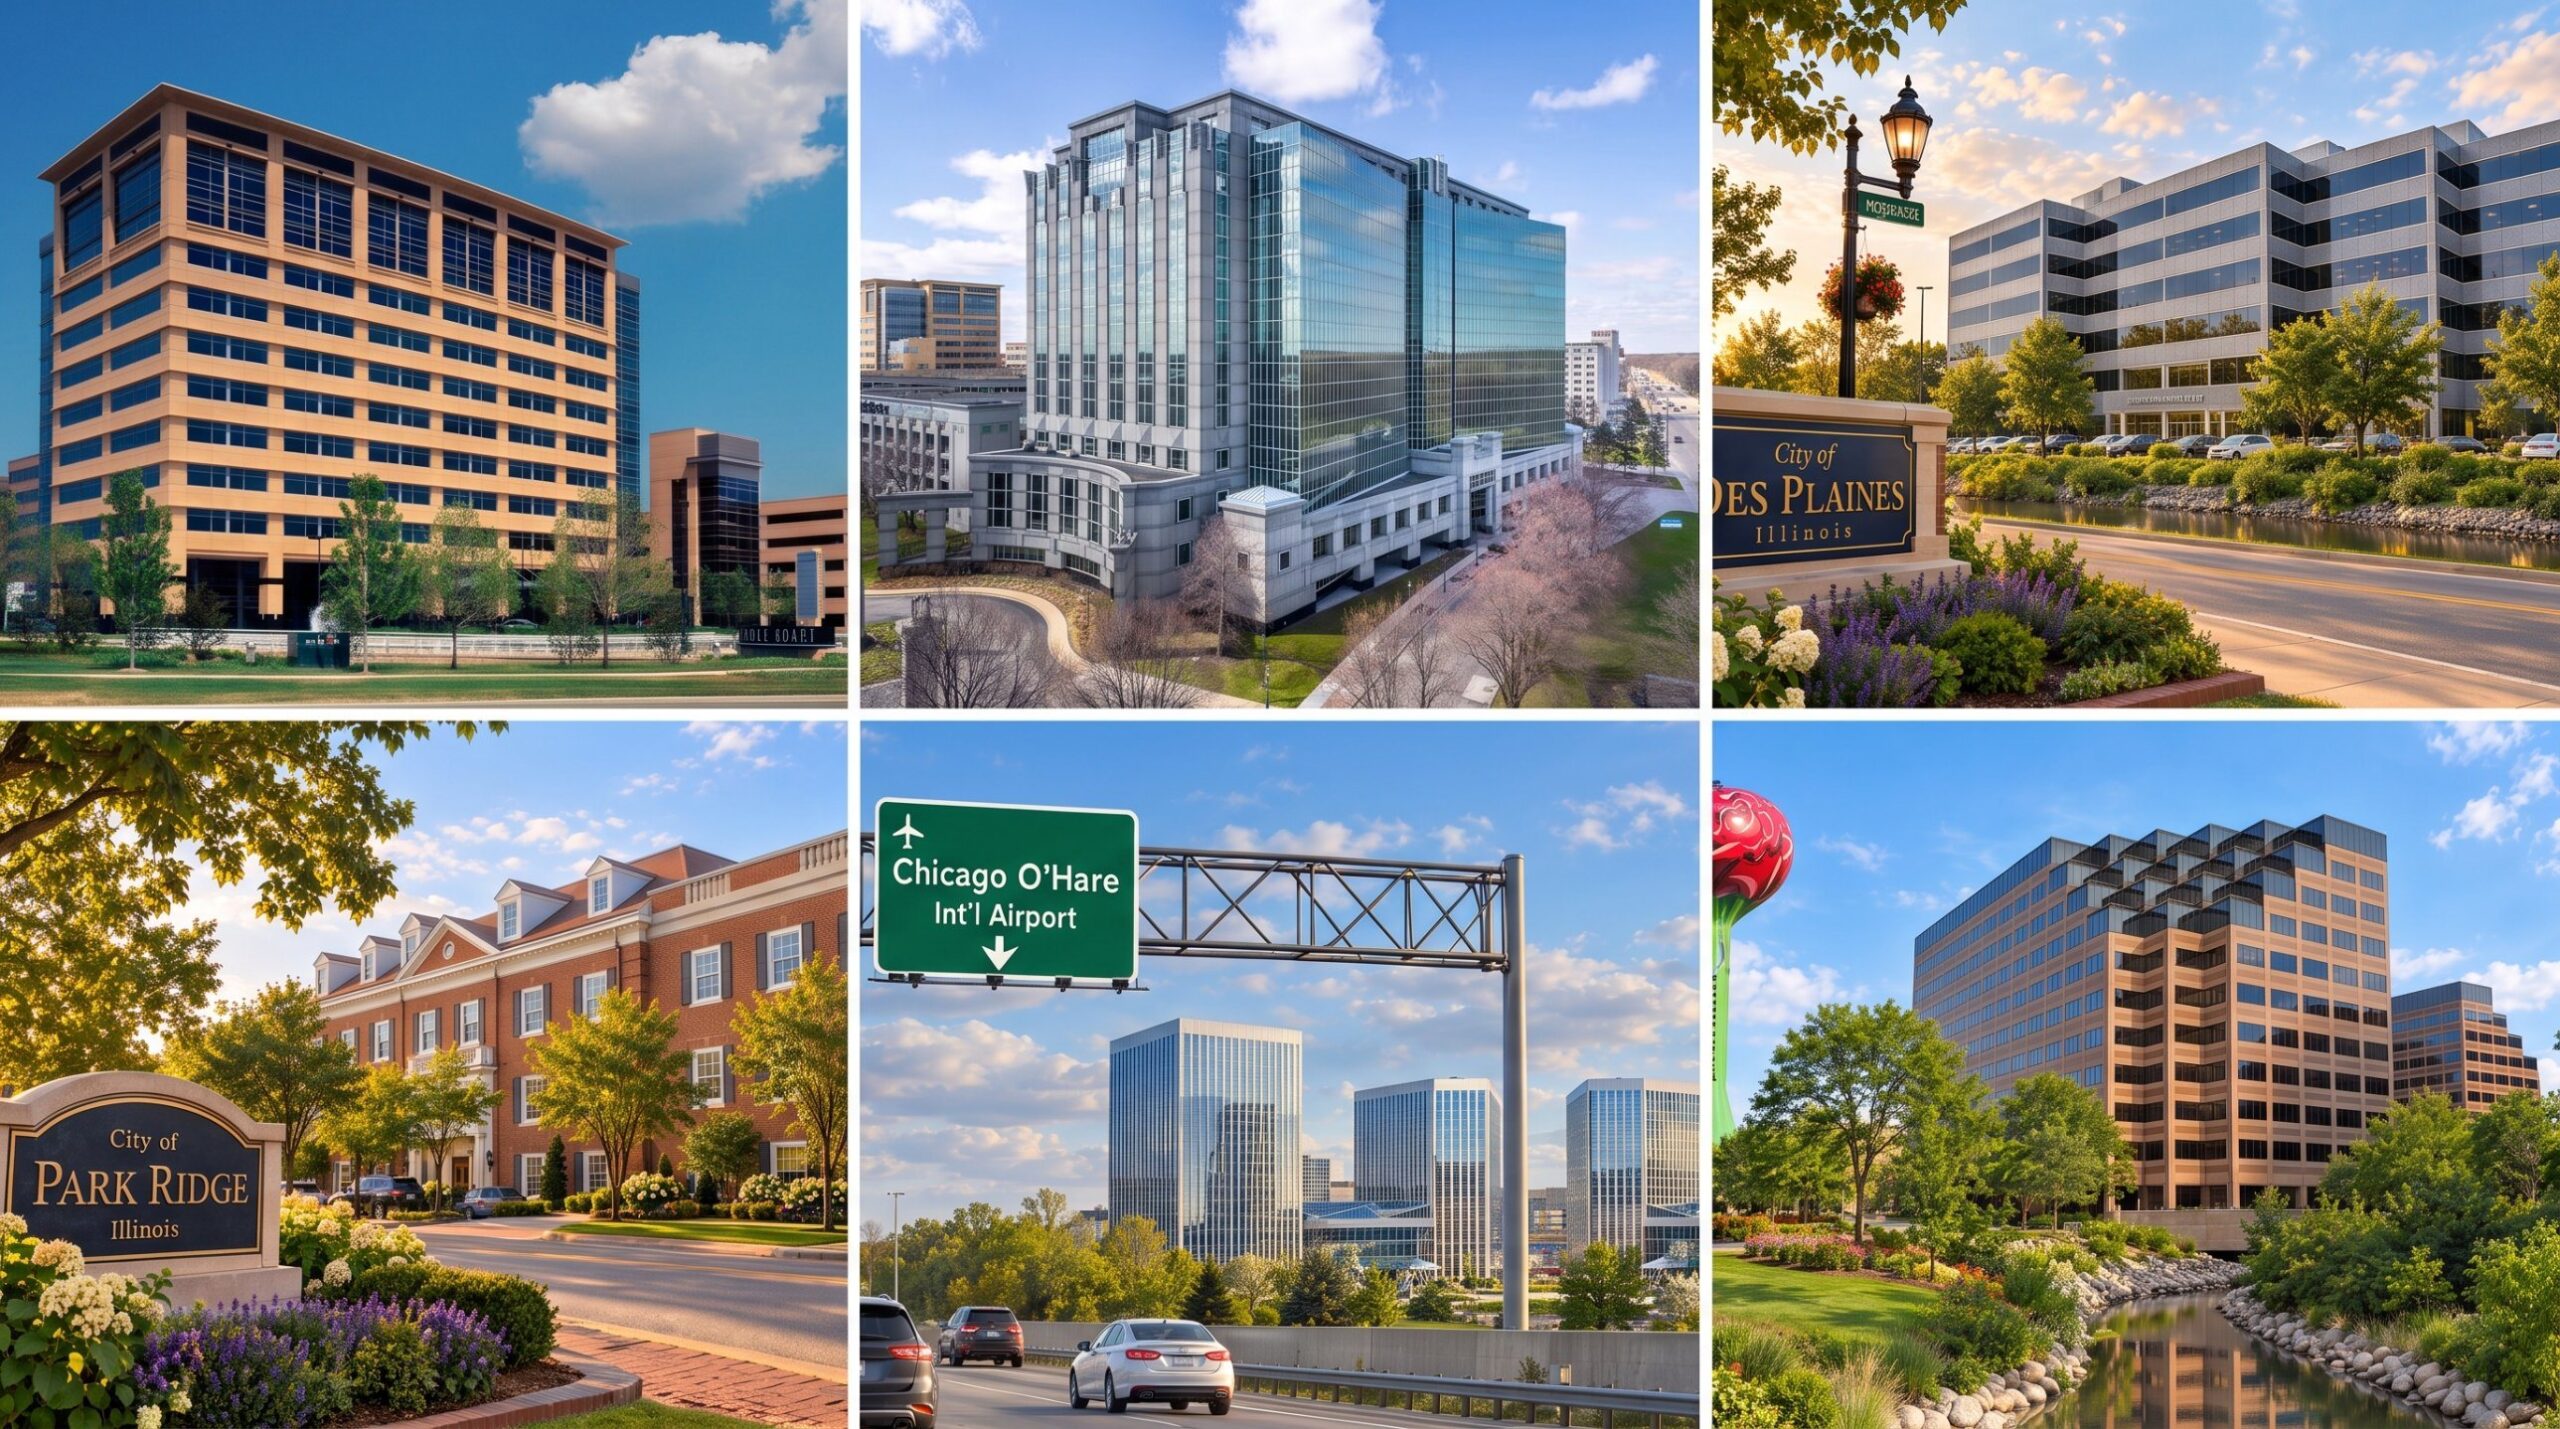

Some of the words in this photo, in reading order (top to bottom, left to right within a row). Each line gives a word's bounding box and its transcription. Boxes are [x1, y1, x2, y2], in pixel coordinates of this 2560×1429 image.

[1775, 442, 1813, 470] City
[1817, 443, 1838, 470] of
[1755, 522, 1852, 544] Illinois
[893, 857, 1007, 895] Chicago
[1018, 862, 1120, 894] O'Hare
[935, 901, 981, 925] Int'l
[989, 903, 1077, 933] Airport
[110, 1128, 152, 1154] City
[159, 1132, 179, 1151] of
[32, 1160, 138, 1206] PARK
[148, 1164, 249, 1205] RIDGE
[111, 1218, 180, 1240] Illinois
